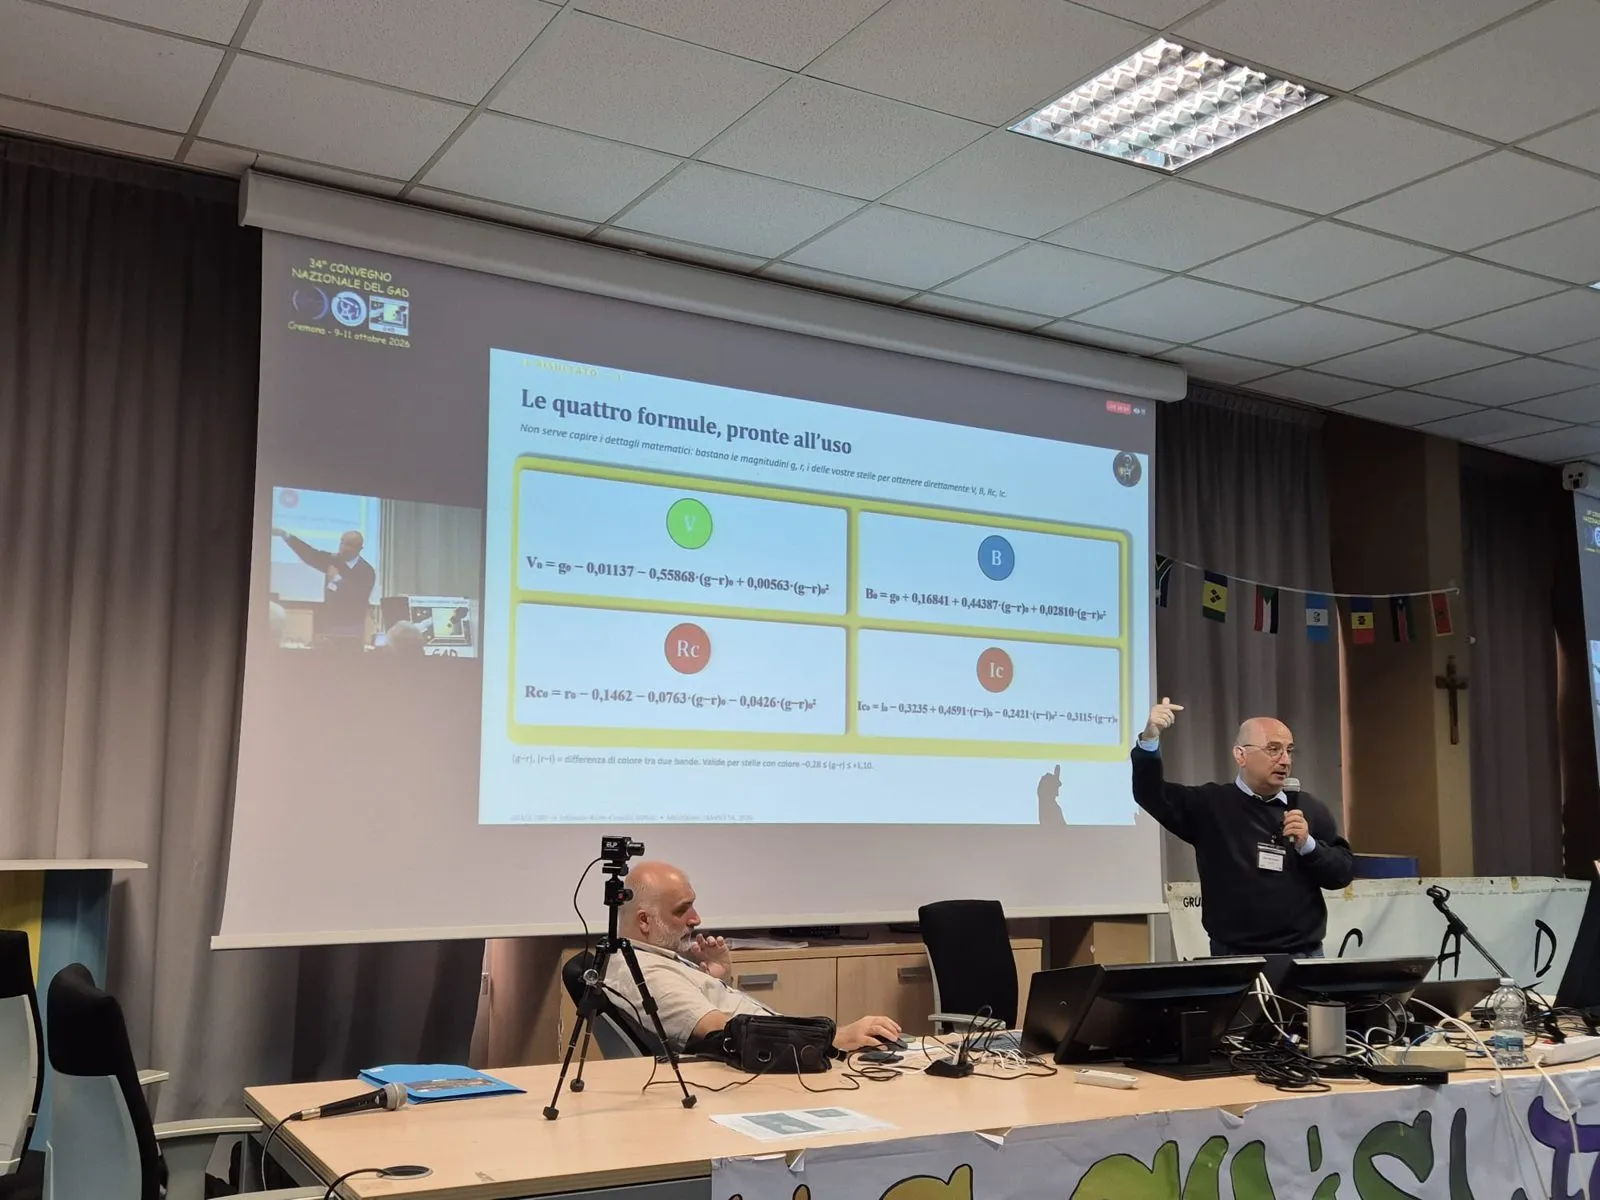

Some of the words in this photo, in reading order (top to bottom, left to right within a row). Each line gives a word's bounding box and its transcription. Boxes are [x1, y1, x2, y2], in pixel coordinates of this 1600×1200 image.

[329, 263, 392, 282] CONVEGNO
[291, 267, 361, 289] NAZIONALE
[363, 280, 384, 294] DEL
[386, 286, 410, 298] GAD
[288, 321, 326, 335] Cremona
[354, 333, 387, 345] ottobre
[521, 388, 547, 410] Le
[552, 397, 632, 422] quattro
[637, 406, 722, 438] formule,
[726, 423, 790, 445] pronte
[520, 423, 540, 434] Non
[542, 429, 567, 438] serve
[569, 431, 598, 443] capire
[604, 434, 640, 448] dettagli
[641, 440, 693, 456] matematici:
[695, 447, 729, 461] bastano
[730, 451, 739, 462] le
[740, 455, 789, 469] magnitudini
[790, 462, 798, 472] g,
[799, 464, 805, 473] r,
[811, 463, 830, 475] delle
[831, 468, 856, 478] vostre
[856, 470, 876, 481] stelle
[877, 473, 891, 484] per
[891, 475, 923, 488] ottenere
[923, 479, 970, 493] direttamente
[971, 485, 978, 495] V,
[978, 486, 986, 497] B,
[987, 487, 998, 498] Rc,
[683, 513, 696, 532] V
[991, 549, 1002, 566] B
[586, 561, 635, 578] 0,01137
[736, 576, 744, 587] +
[911, 592, 949, 607] 0,16841
[676, 639, 700, 658] Rc
[988, 661, 1004, 679] Ic
[592, 688, 633, 703] 0,1462
[898, 703, 929, 715] 0,3235
[564, 754, 606, 764] differenza
[607, 754, 616, 764] di
[617, 755, 642, 765] colore
[644, 756, 656, 766] tra
[657, 755, 672, 765] due
[702, 758, 725, 767] Valide
[727, 759, 739, 769] per
[741, 759, 761, 768] stelle
[763, 760, 776, 768] con
[777, 759, 800, 769] colore
[1183, 896, 1202, 908] GRU
